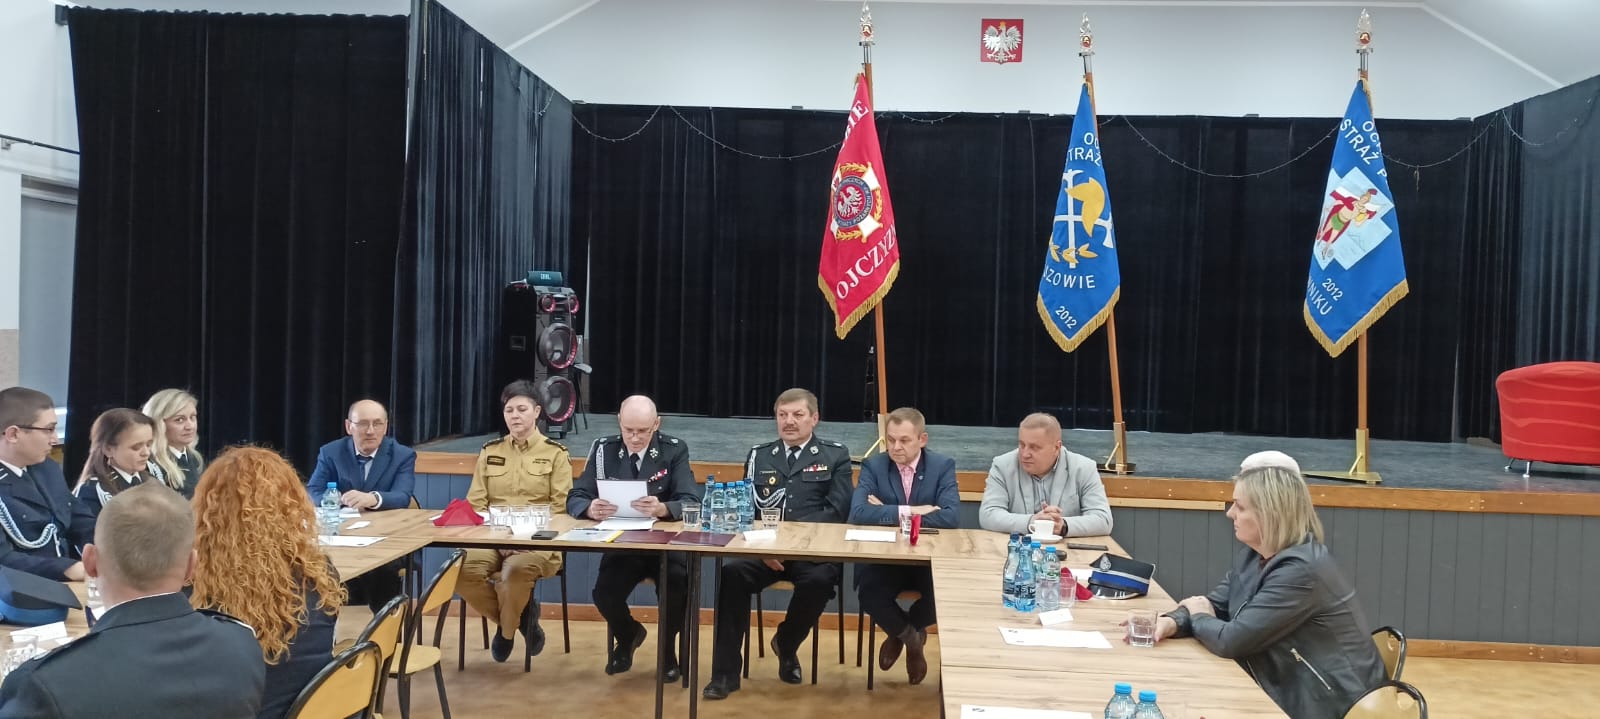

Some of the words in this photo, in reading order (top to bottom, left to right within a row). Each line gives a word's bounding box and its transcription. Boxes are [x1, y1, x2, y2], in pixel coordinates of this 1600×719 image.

[1340, 119, 1379, 165] STRAŻ
[1322, 278, 1344, 301] 2012
[1055, 305, 1077, 329] 2012
